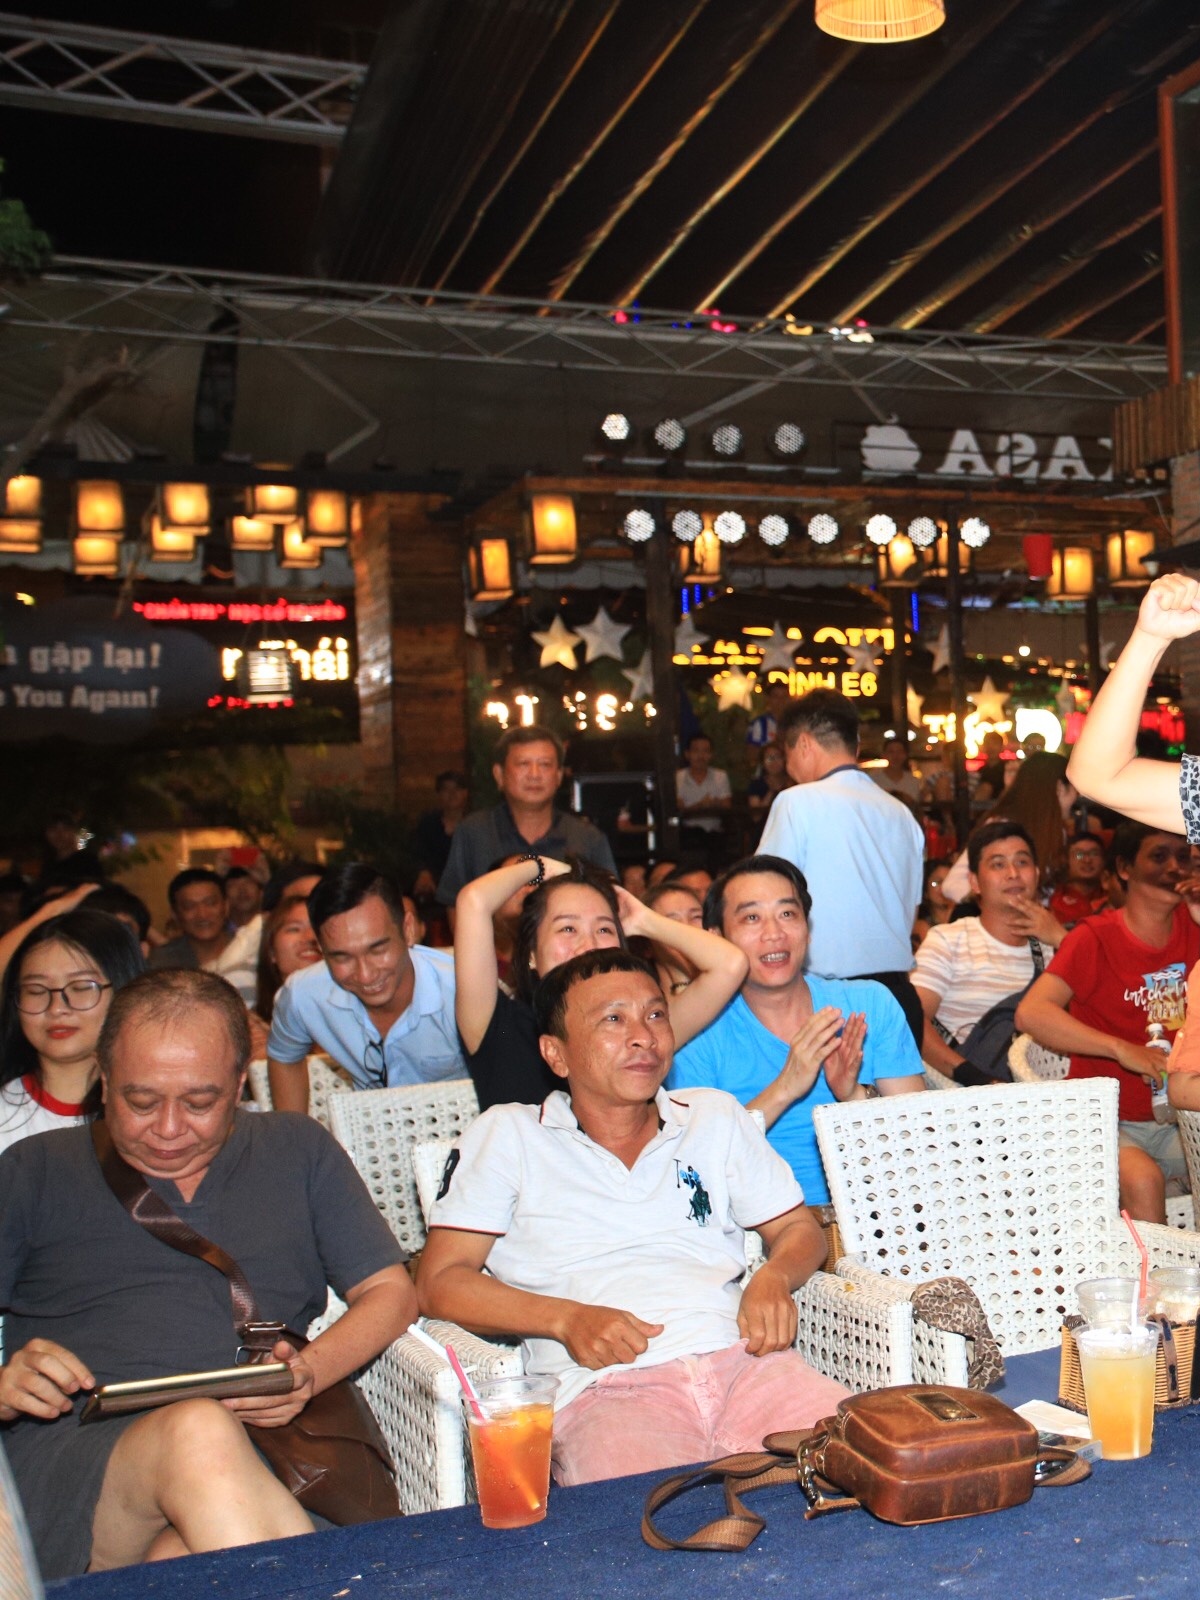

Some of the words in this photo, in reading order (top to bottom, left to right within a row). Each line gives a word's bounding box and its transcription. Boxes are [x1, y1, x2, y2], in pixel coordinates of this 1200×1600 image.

[841, 671, 878, 697] E6
[11, 683, 64, 708] You
[70, 684, 160, 714] Again!
